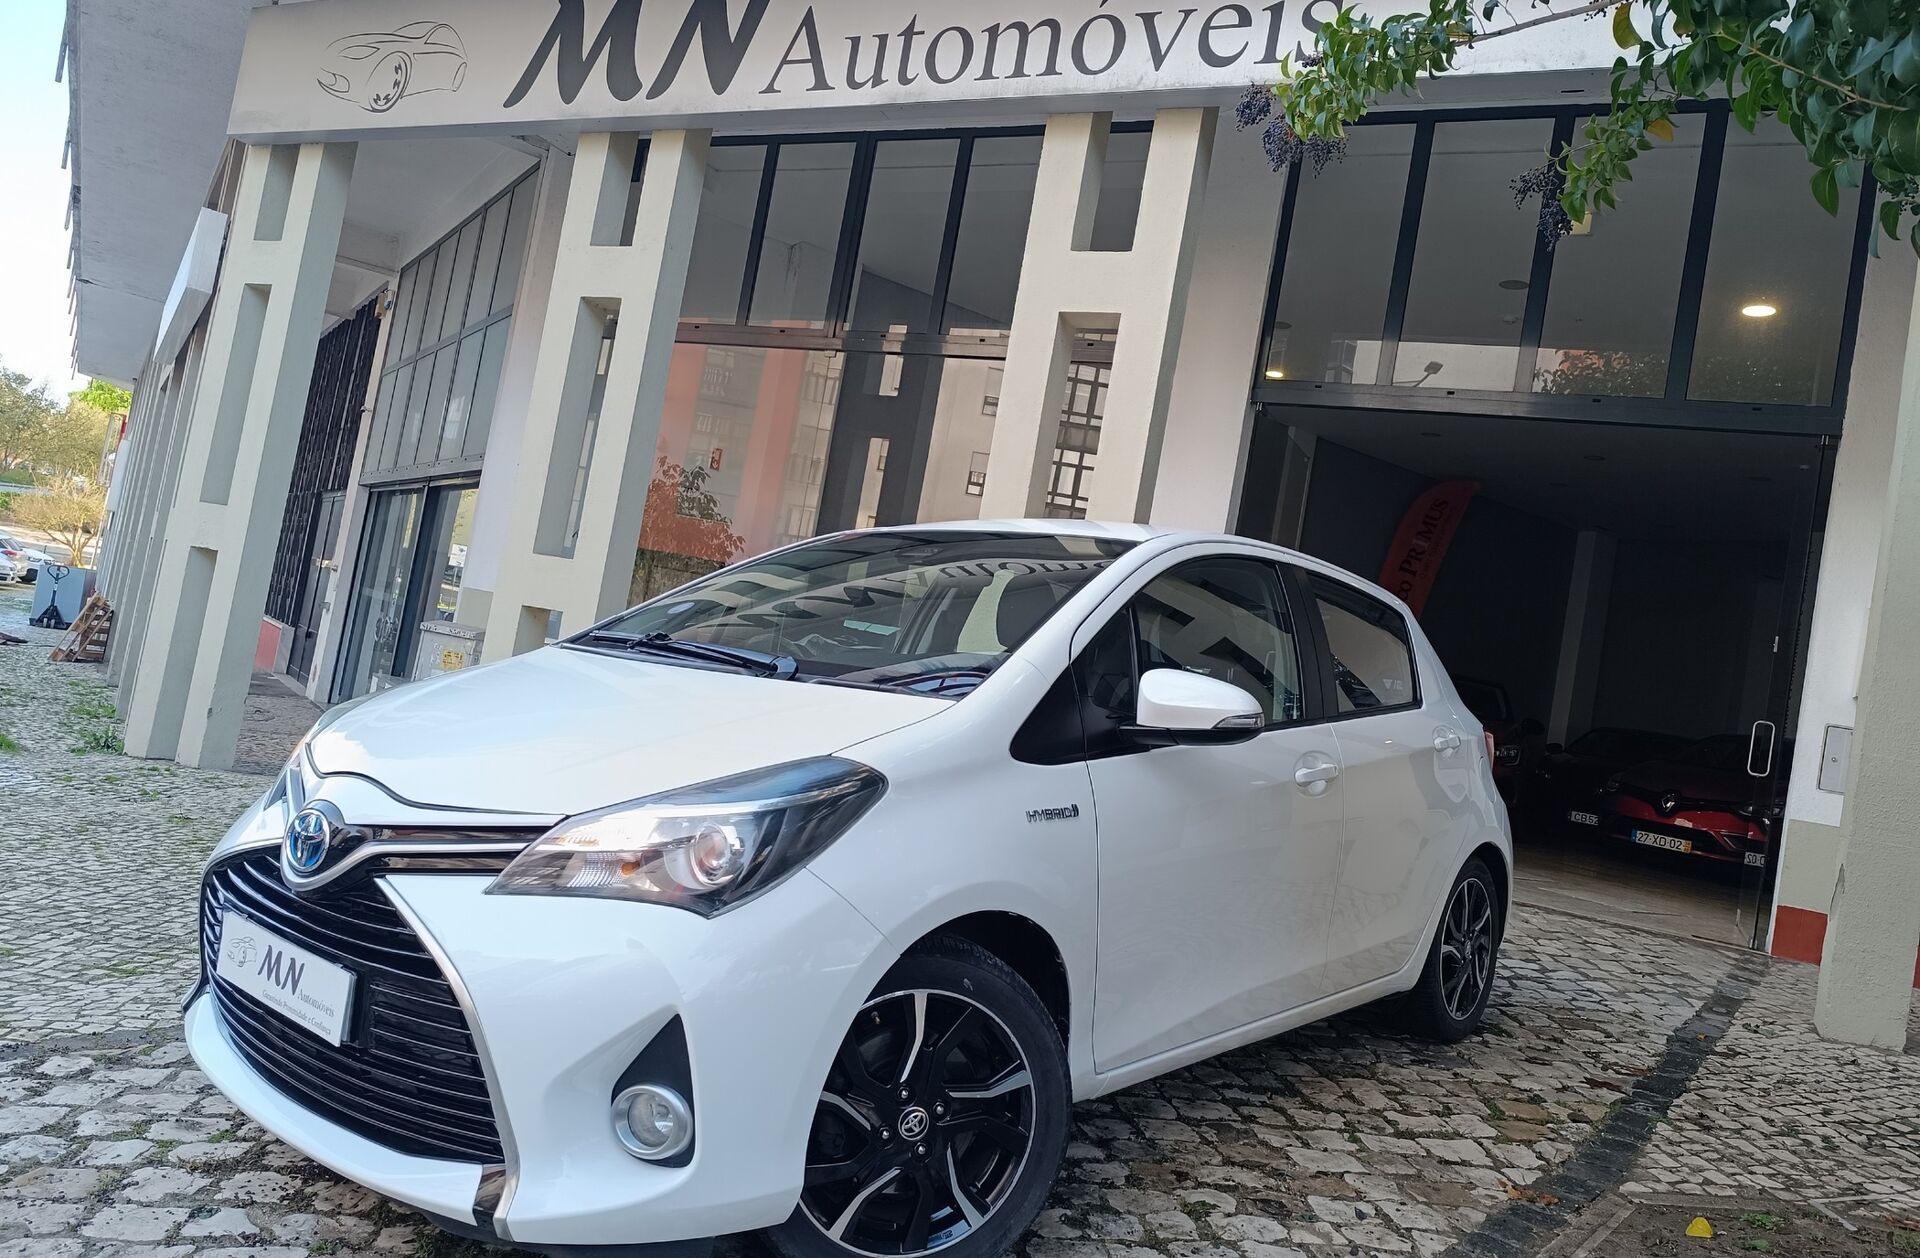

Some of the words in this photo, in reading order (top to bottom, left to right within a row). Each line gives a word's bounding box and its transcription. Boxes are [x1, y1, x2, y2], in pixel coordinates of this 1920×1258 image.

[503, 0, 770, 108] MN
[758, 0, 1344, 95] Automóveis
[1398, 499, 1449, 577] PRIMUS
[1025, 807, 1073, 823] HYBRID
[258, 944, 305, 996] MN
